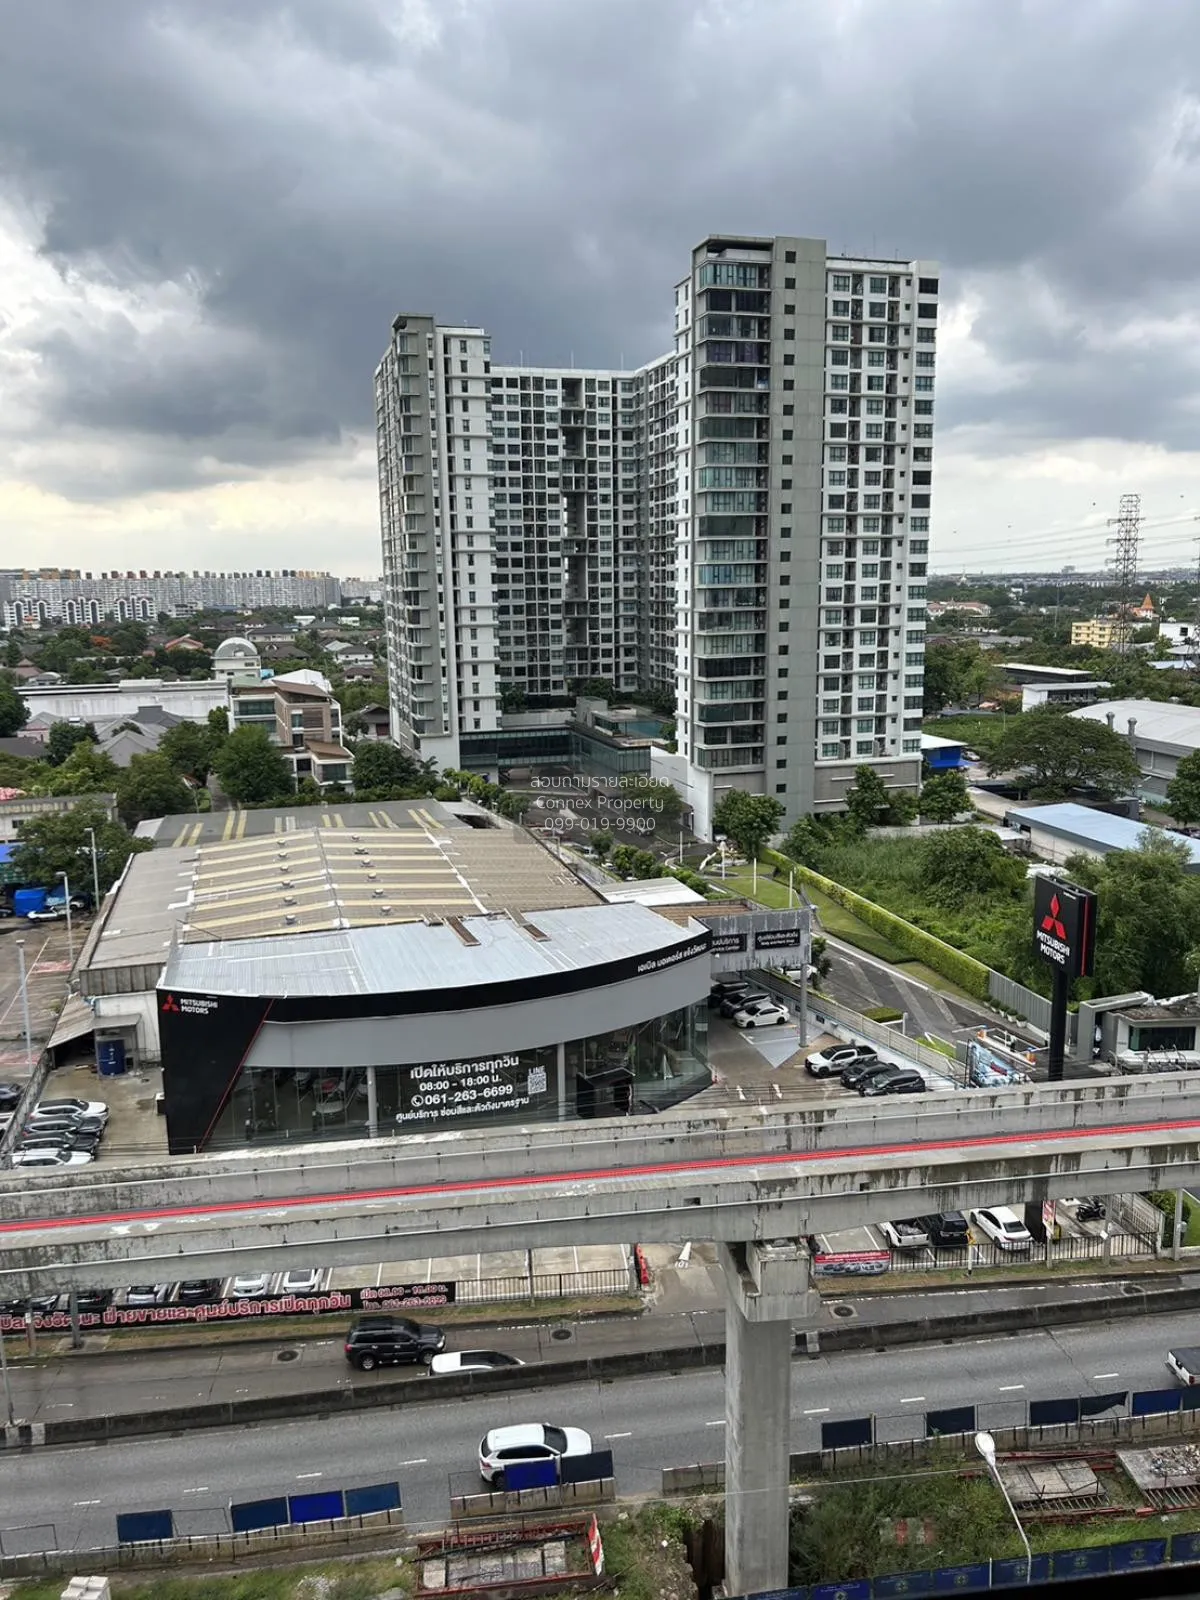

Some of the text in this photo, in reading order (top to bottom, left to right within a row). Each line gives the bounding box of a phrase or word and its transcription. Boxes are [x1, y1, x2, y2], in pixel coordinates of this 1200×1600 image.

[1037, 929, 1070, 957] MITSUBISHI
[1040, 943, 1065, 965] MOTORS
[180, 998, 218, 1008] MITSUBISHI
[181, 1005, 209, 1014] MOTORS
[410, 1055, 519, 1079] เปิดให้บริการทุกวัน
[528, 1065, 545, 1076] LINE
[419, 1080, 450, 1092] 08:00
[460, 1076, 490, 1088] 18:00
[491, 1073, 503, 1083] น.
[424, 1084, 513, 1105] 061-263-6699
